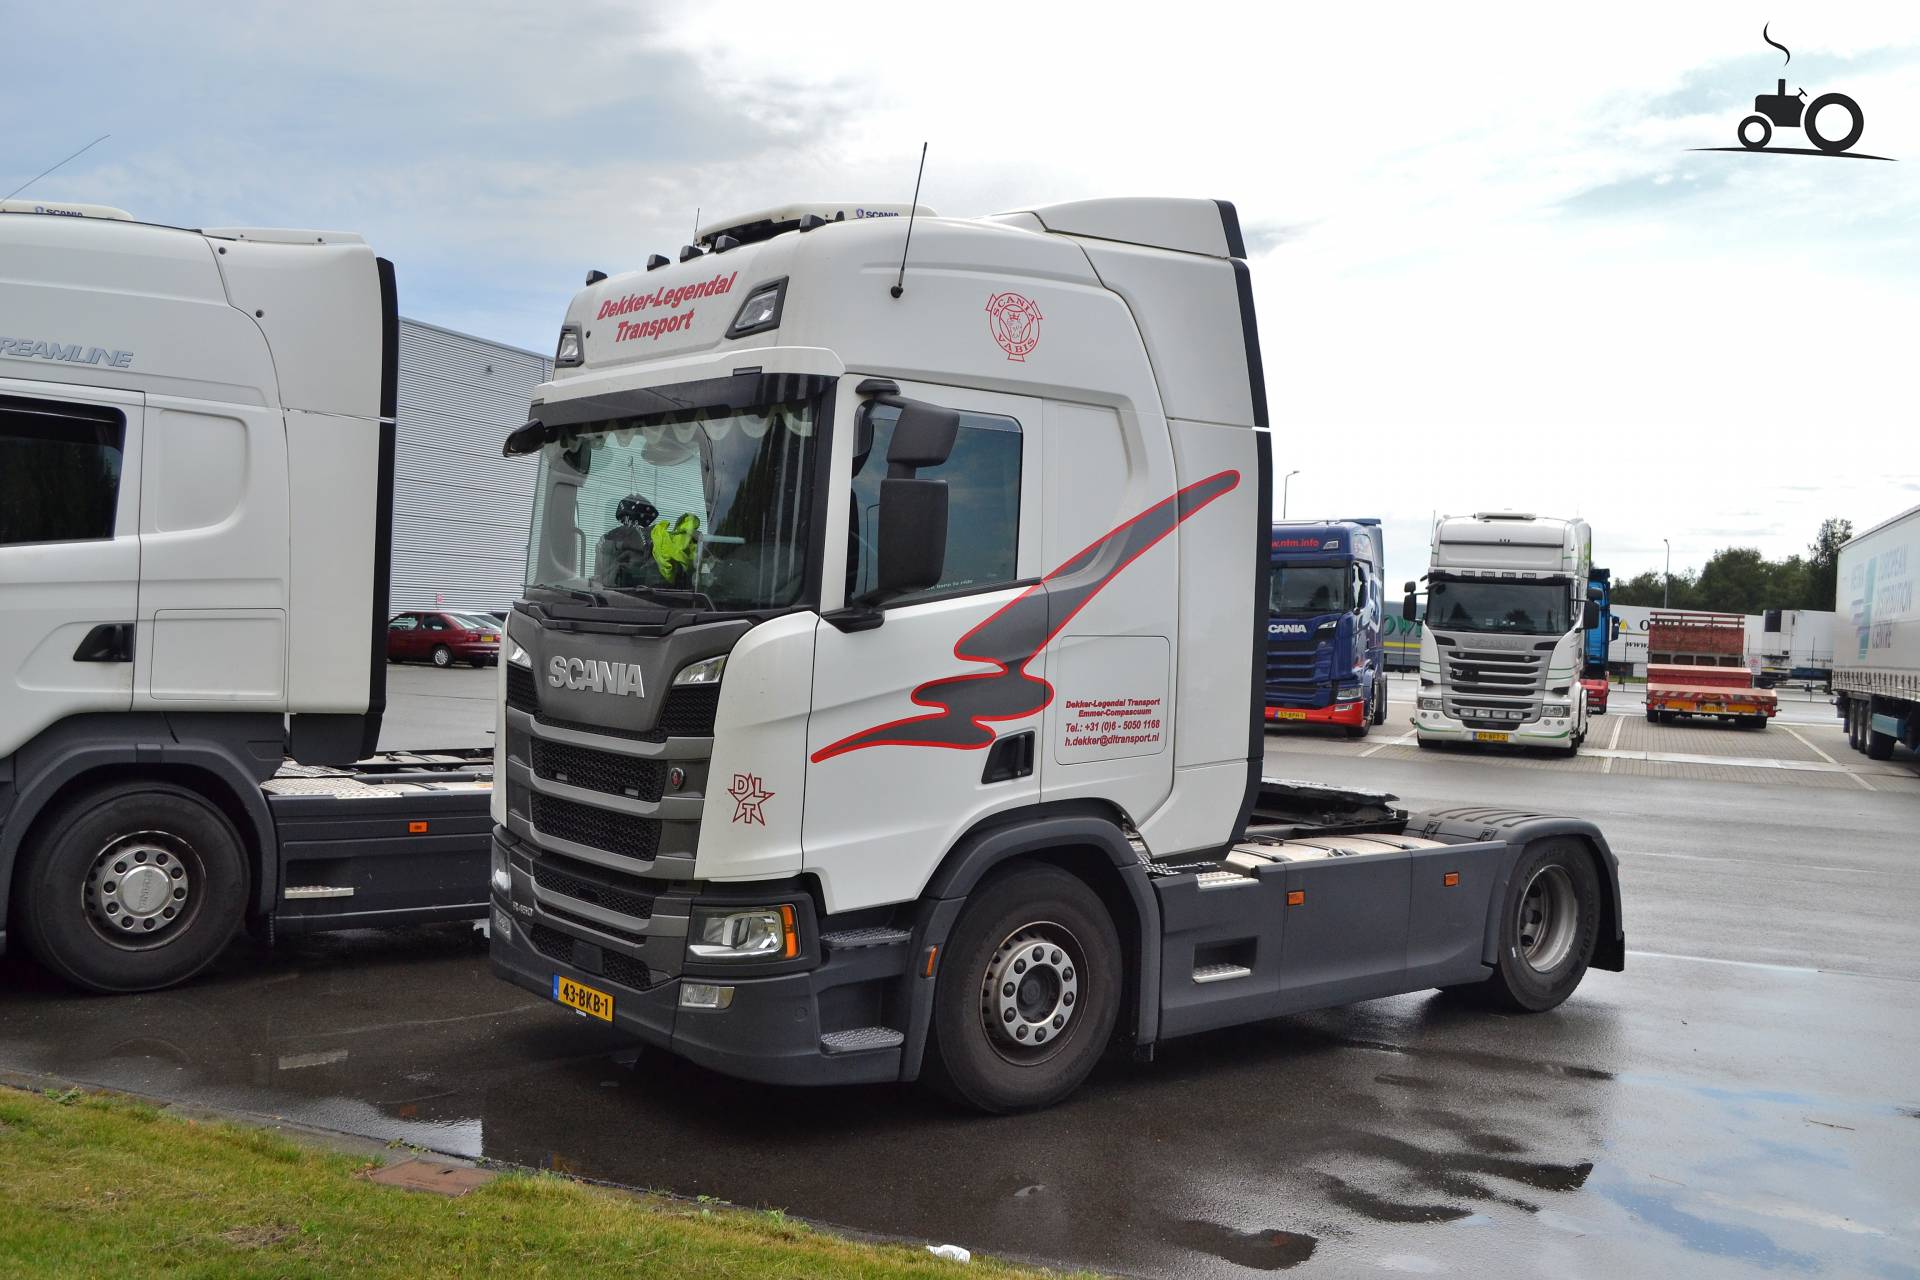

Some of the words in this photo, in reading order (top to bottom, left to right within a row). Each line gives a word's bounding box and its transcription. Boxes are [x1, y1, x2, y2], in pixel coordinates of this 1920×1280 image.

[597, 271, 738, 320] Dekker-Legendal
[993, 296, 1035, 323] SCANIA
[615, 308, 695, 342] Transport
[0, 336, 134, 368] REAMLINE
[998, 333, 1035, 353] VABIS
[1268, 624, 1308, 634] CANIA
[548, 655, 645, 699] SCANIA
[1066, 699, 1126, 709] Dekker-Legendal
[1128, 698, 1161, 707] Transport
[1078, 708, 1152, 718] Emmer-Compascuum
[1085, 722, 1099, 732] +31
[1123, 720, 1141, 730] 5050
[1064, 732, 1160, 747] h.dekker@dltransport.nl
[563, 982, 609, 1016] 43-BKB-1
